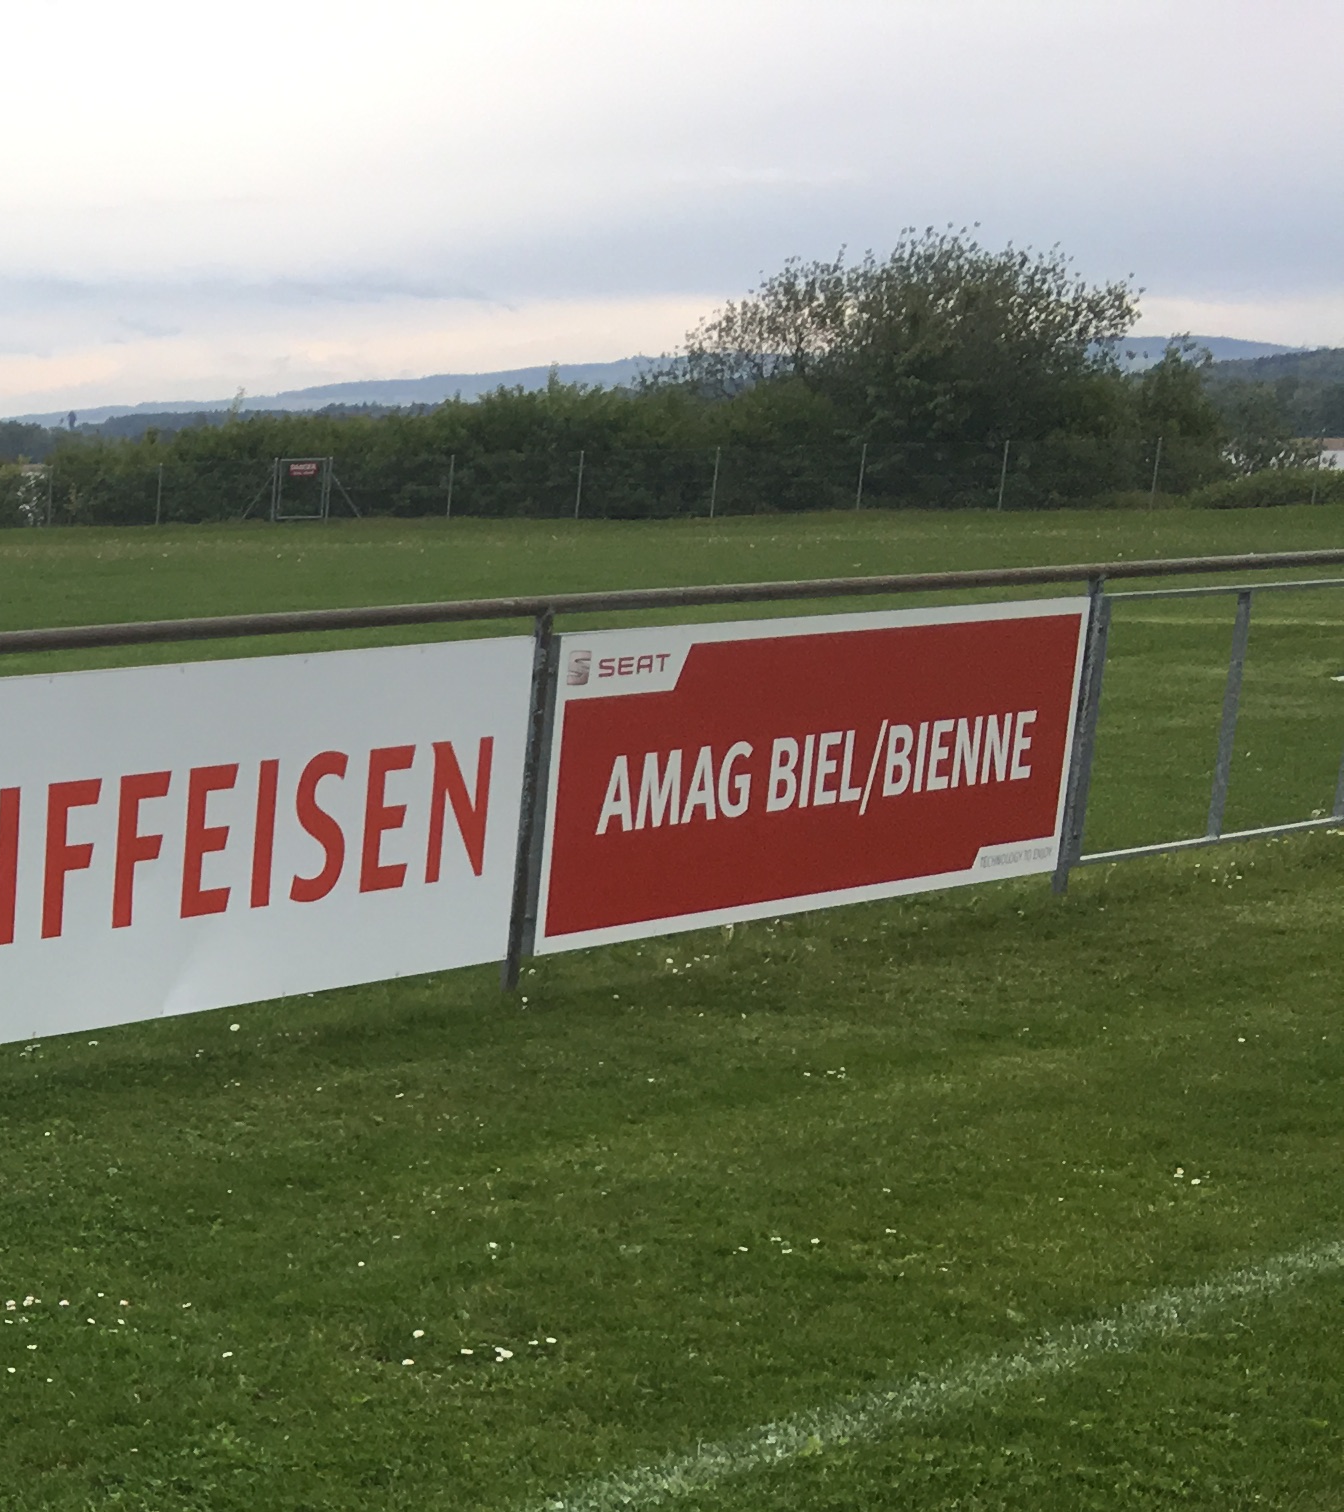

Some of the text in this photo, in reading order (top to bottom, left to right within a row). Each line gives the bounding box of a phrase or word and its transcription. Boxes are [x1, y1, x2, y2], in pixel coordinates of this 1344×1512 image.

[598, 653, 671, 678] SEAT
[595, 709, 1038, 836] AMAG BIEL/BIENNE
[979, 852, 1023, 869] TECHNOLOGY
